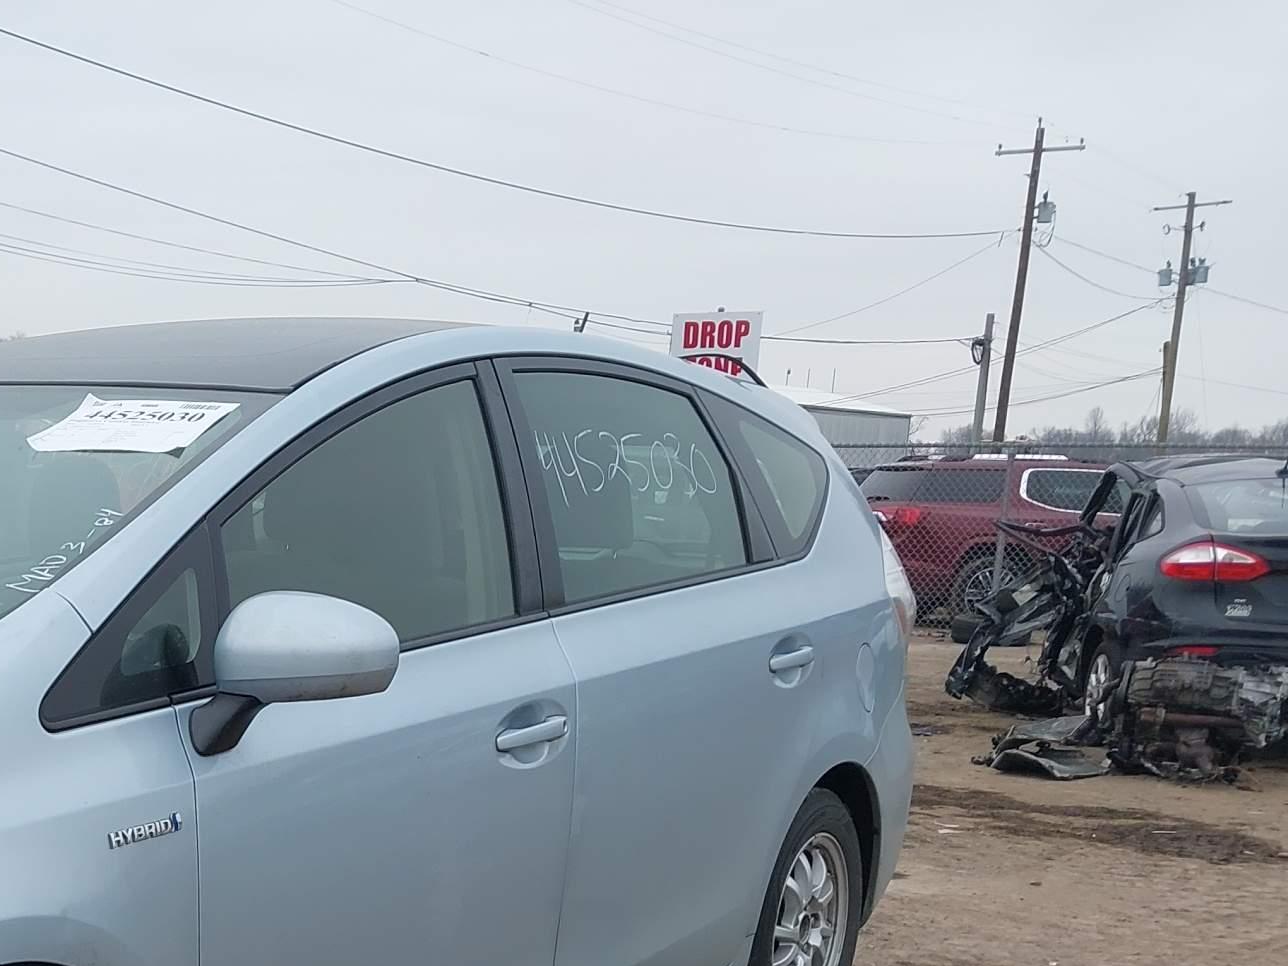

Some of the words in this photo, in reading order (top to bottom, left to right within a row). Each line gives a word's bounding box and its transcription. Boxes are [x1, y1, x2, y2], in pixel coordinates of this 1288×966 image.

[682, 319, 750, 349] DROP
[83, 409, 207, 424] 44525030
[534, 428, 717, 508] 44525030
[4, 554, 68, 593] MAD
[107, 818, 173, 849] HYBRID
